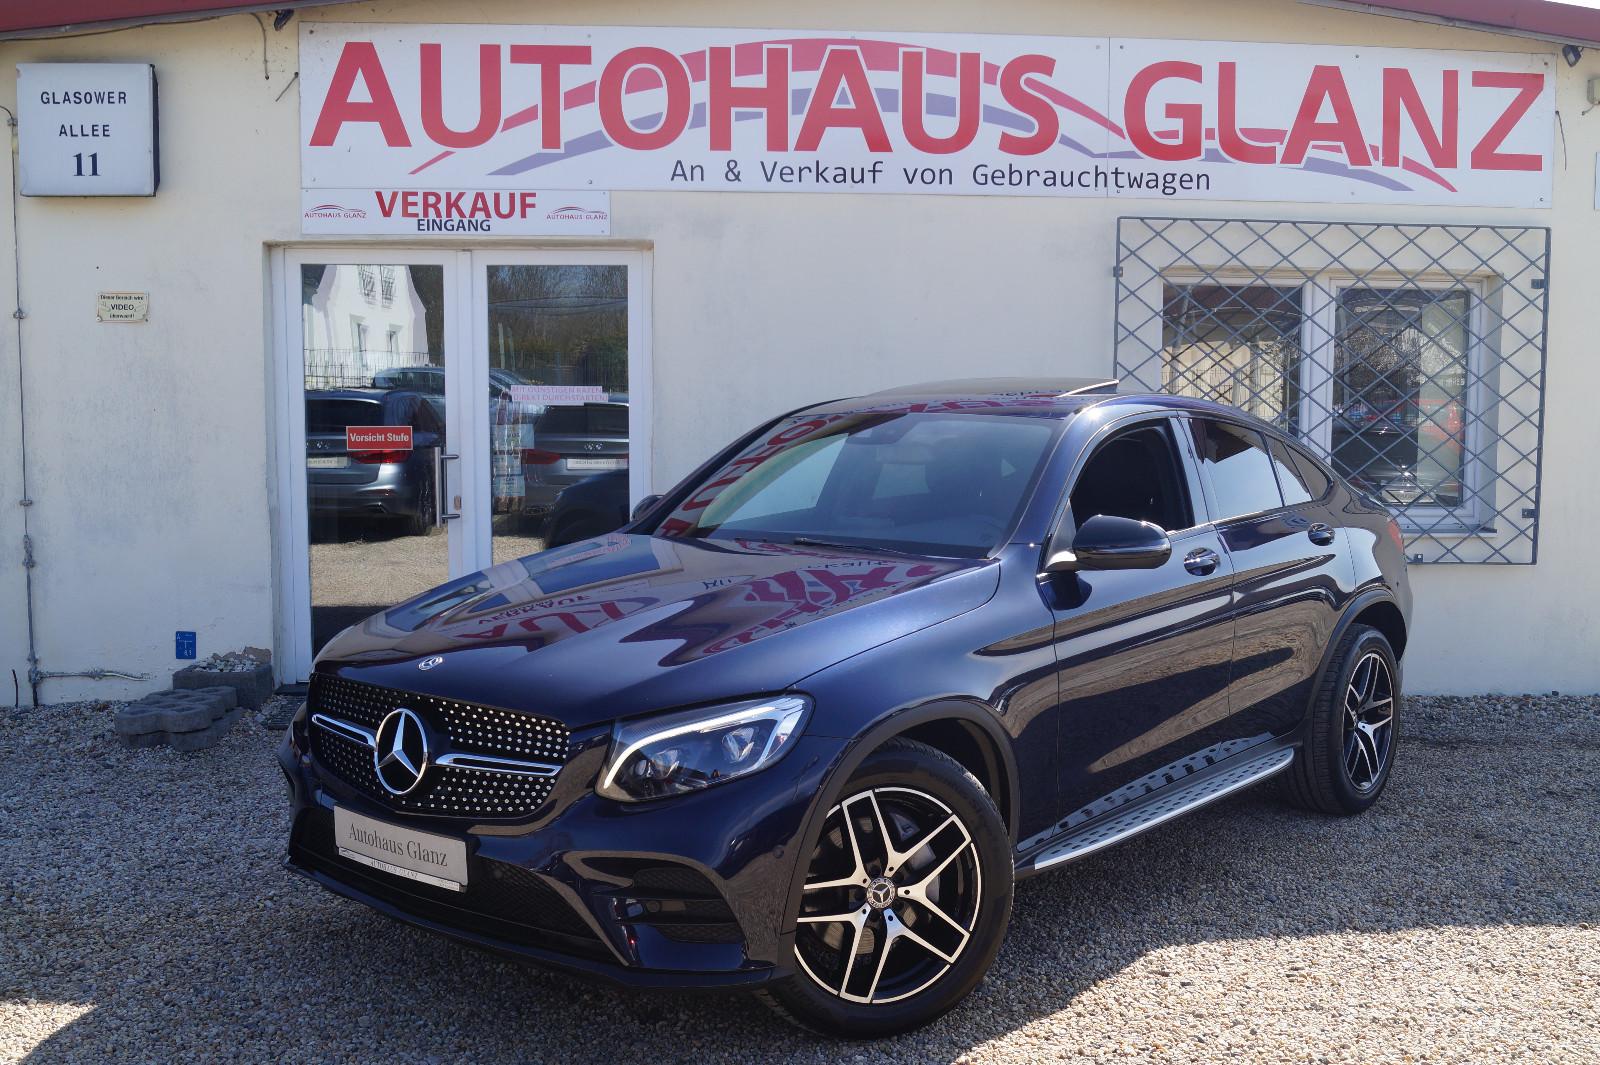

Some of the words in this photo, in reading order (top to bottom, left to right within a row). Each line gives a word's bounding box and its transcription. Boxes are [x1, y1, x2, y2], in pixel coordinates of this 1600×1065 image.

[40, 91, 127, 104] GLASOWER
[308, 41, 1060, 156] AUTOHAUS
[1123, 60, 1545, 172] GLANZ
[58, 124, 111, 137] ALLEE
[72, 151, 101, 177] 11
[671, 159, 705, 182] An
[724, 159, 742, 182] &
[760, 160, 884, 185] Verkauf
[903, 167, 953, 186] von
[972, 163, 1211, 196] Gebrauchtwagen
[374, 190, 537, 219] VERKAUF
[417, 219, 491, 232] EINGANG
[349, 432, 385, 442] Vorsicht
[386, 432, 409, 442] Stufe
[348, 823, 404, 856] Autohaus
[406, 840, 448, 867] Glanz
